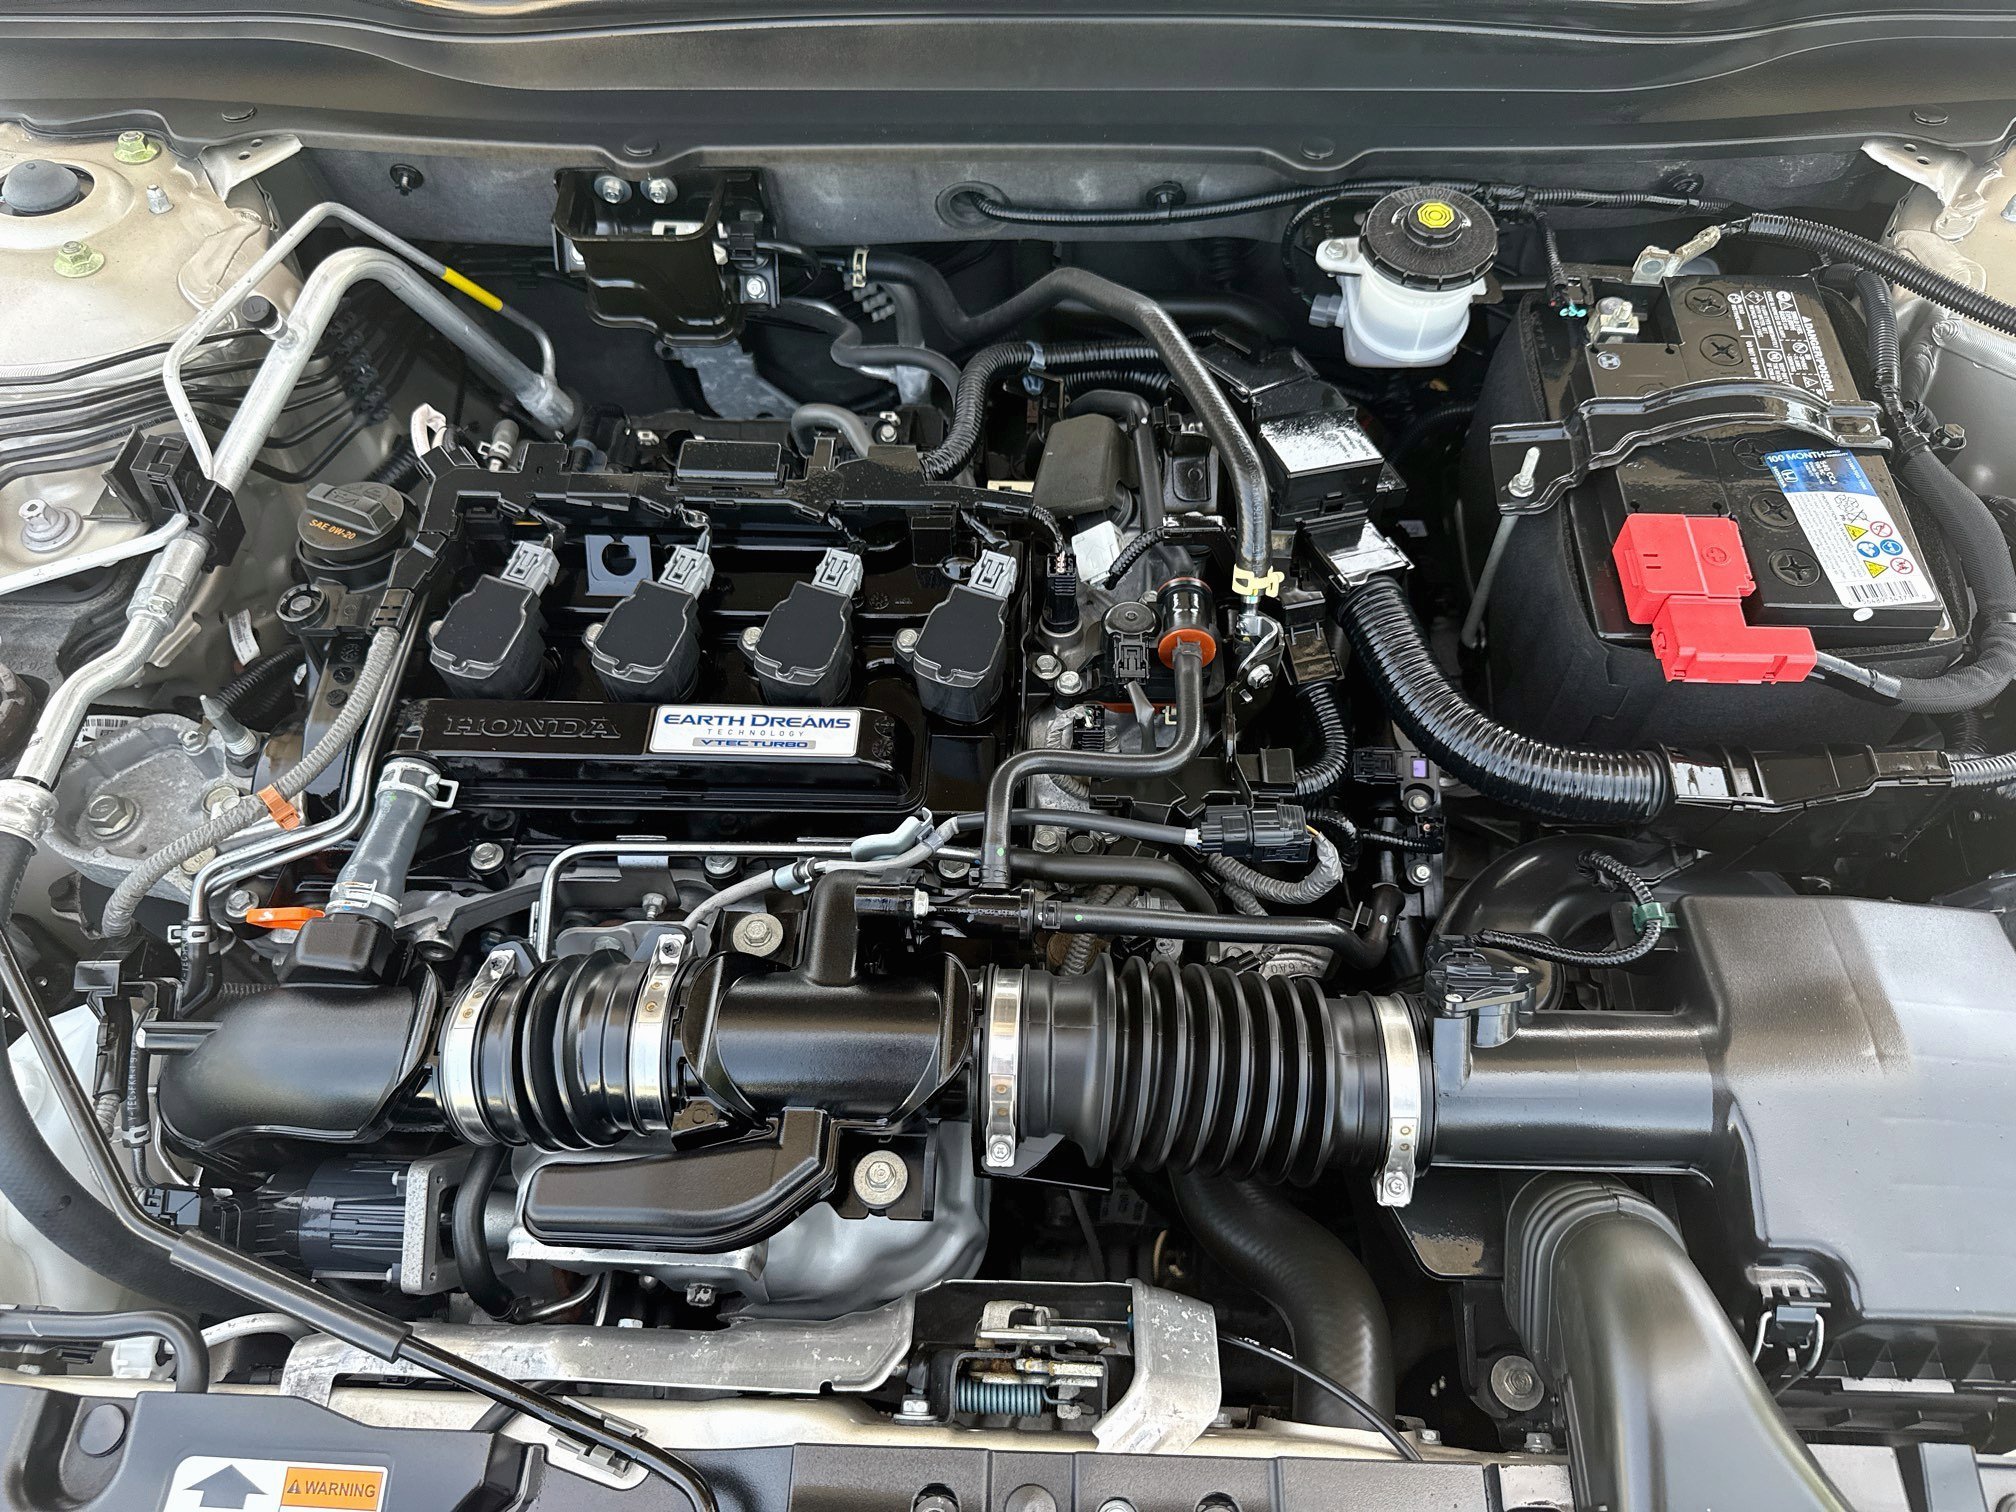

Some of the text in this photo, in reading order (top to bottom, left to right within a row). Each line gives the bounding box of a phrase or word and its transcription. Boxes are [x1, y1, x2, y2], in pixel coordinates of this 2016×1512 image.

[1806, 323, 1835, 392] DANGER/POISON
[1767, 454, 1785, 463] 100
[1786, 451, 1825, 461] MONTH
[1772, 466, 1787, 488] HONDA
[1827, 472, 1838, 485] CCA
[309, 519, 356, 540] SAE 0W-20
[443, 714, 851, 739] HONDA EARTH DREAMS
[707, 728, 805, 737] TECHNOLOGY
[750, 740, 808, 748] TURBO
[305, 1480, 376, 1498] WARNING
